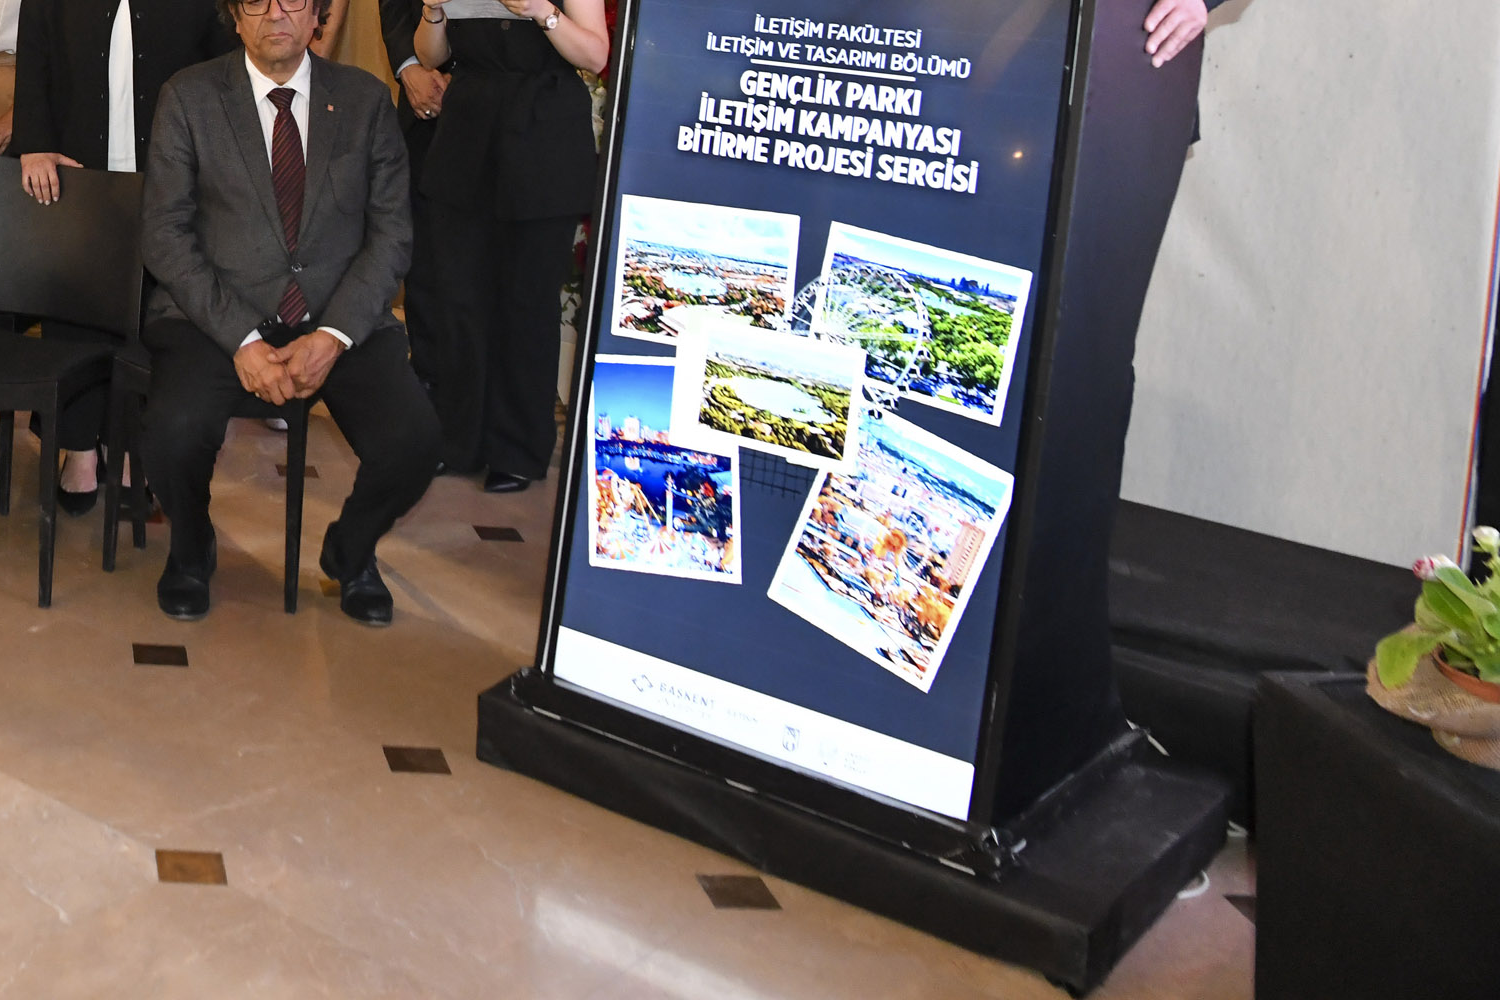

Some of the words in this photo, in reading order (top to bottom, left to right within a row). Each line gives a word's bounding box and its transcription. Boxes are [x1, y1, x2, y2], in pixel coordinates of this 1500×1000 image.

[754, 13, 824, 39] İLETİŞİM
[827, 23, 923, 50] FAKÜLTESİ
[706, 32, 774, 57] İLETİŞİM
[777, 42, 800, 60] VE
[805, 44, 886, 70] TASARIMI
[890, 53, 971, 80] BÖLÜMÜ
[740, 70, 842, 106] GENÇLİK
[845, 82, 922, 117] PARKI
[699, 92, 794, 133] İLETİŞİM
[799, 110, 961, 157] KAMPANYASI
[677, 123, 770, 164] BİTİRME
[773, 142, 874, 179] PROJESİ
[876, 153, 979, 194] SERGİSİ
